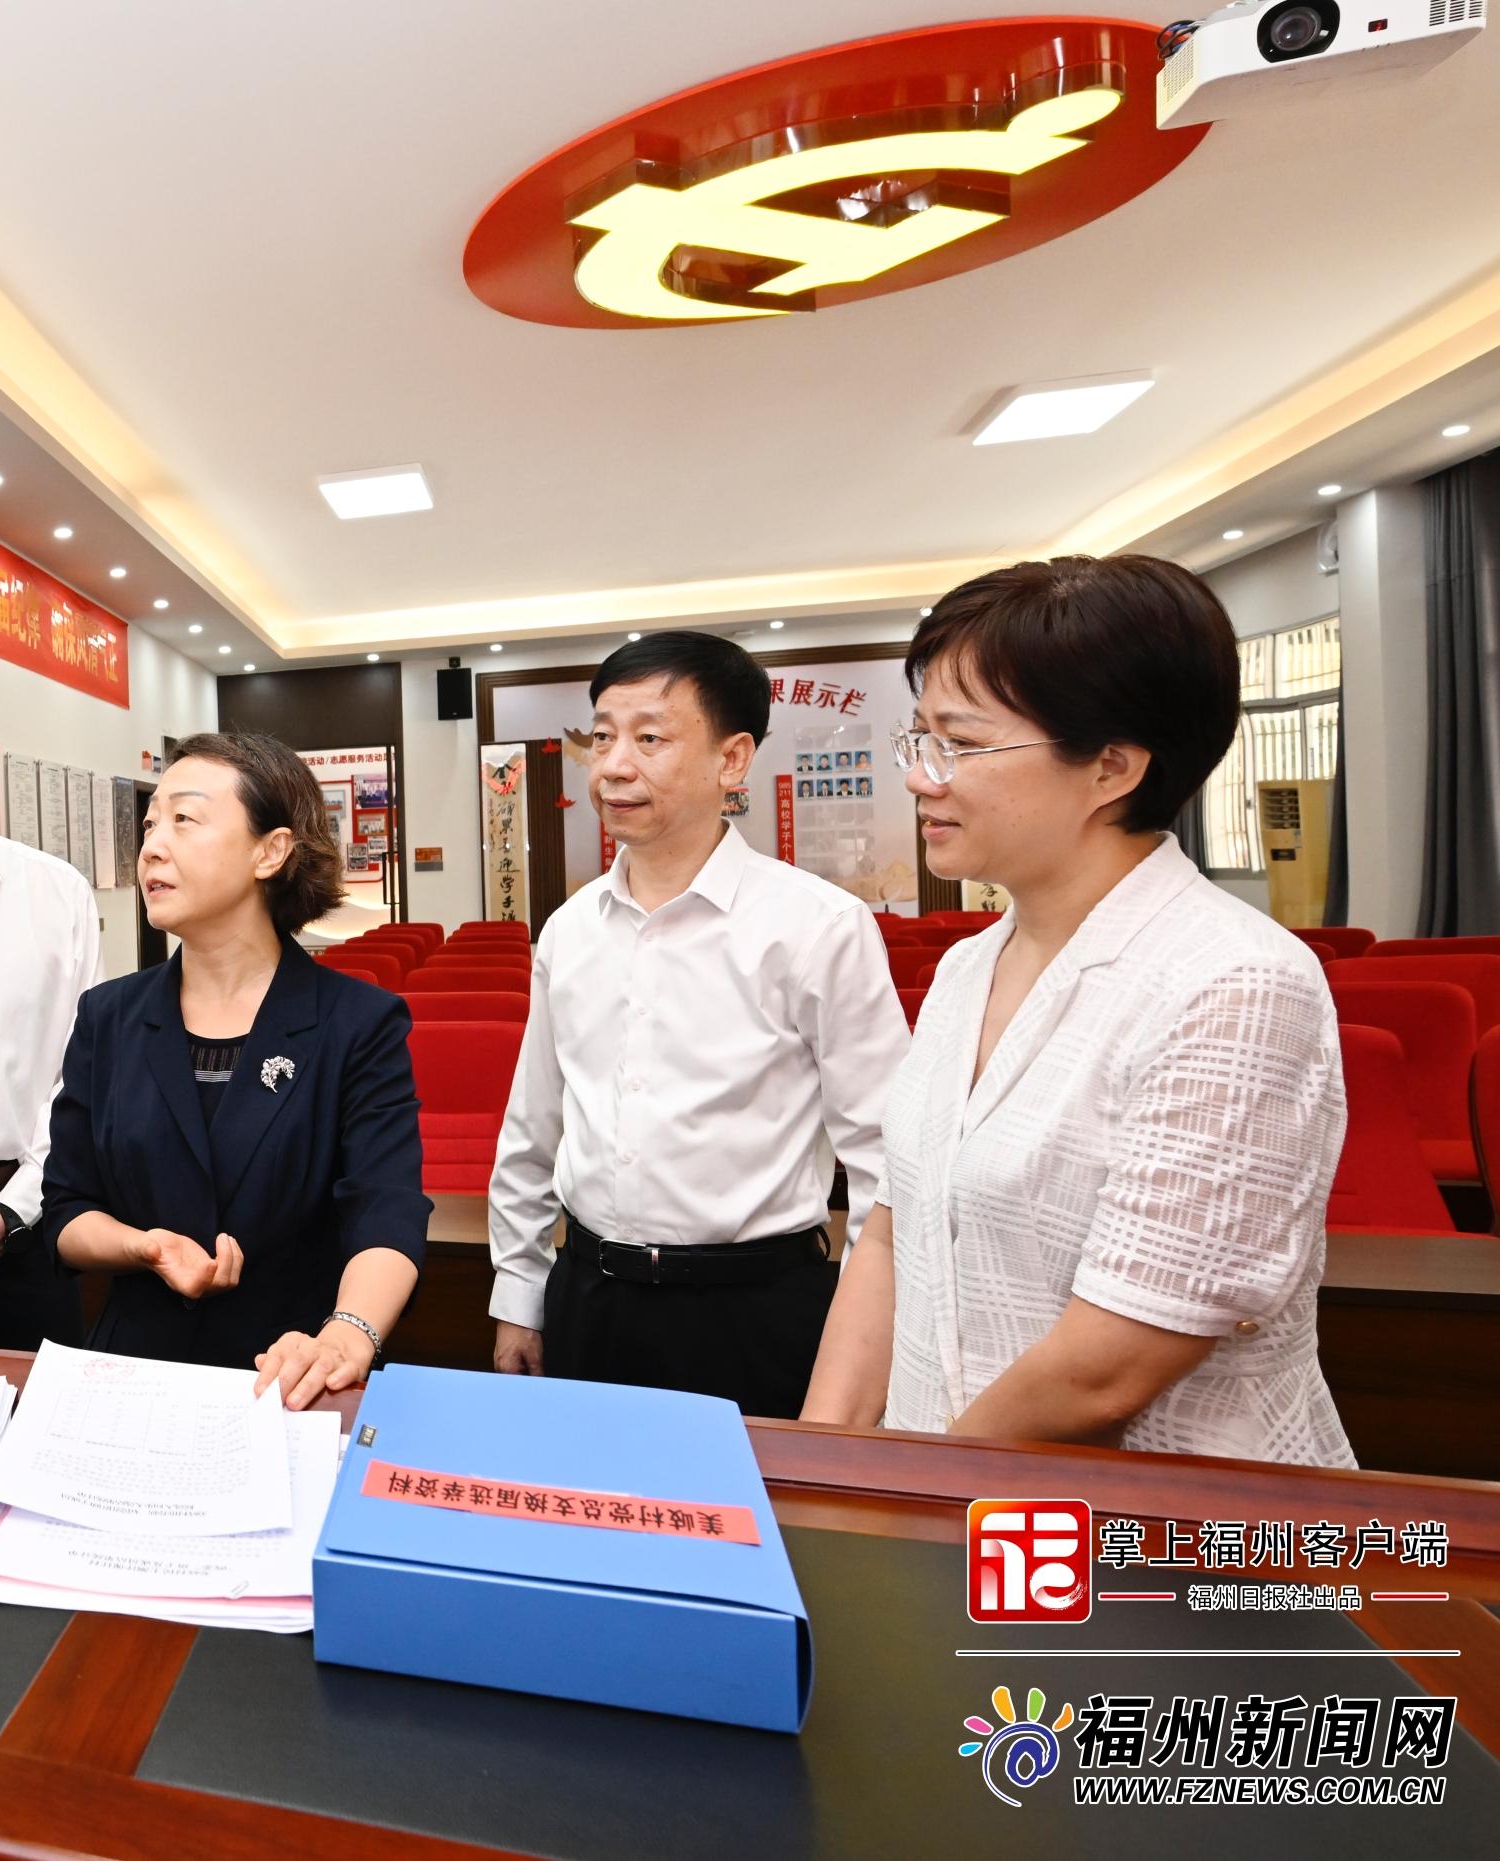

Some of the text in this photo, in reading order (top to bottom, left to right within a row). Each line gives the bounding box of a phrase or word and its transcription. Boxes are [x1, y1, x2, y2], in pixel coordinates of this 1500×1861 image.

[771, 678, 867, 716] 果展示栏
[303, 753, 388, 766] 活动/志愿服务活动
[388, 1470, 725, 1537] 美岐村党总支换届选举资料
